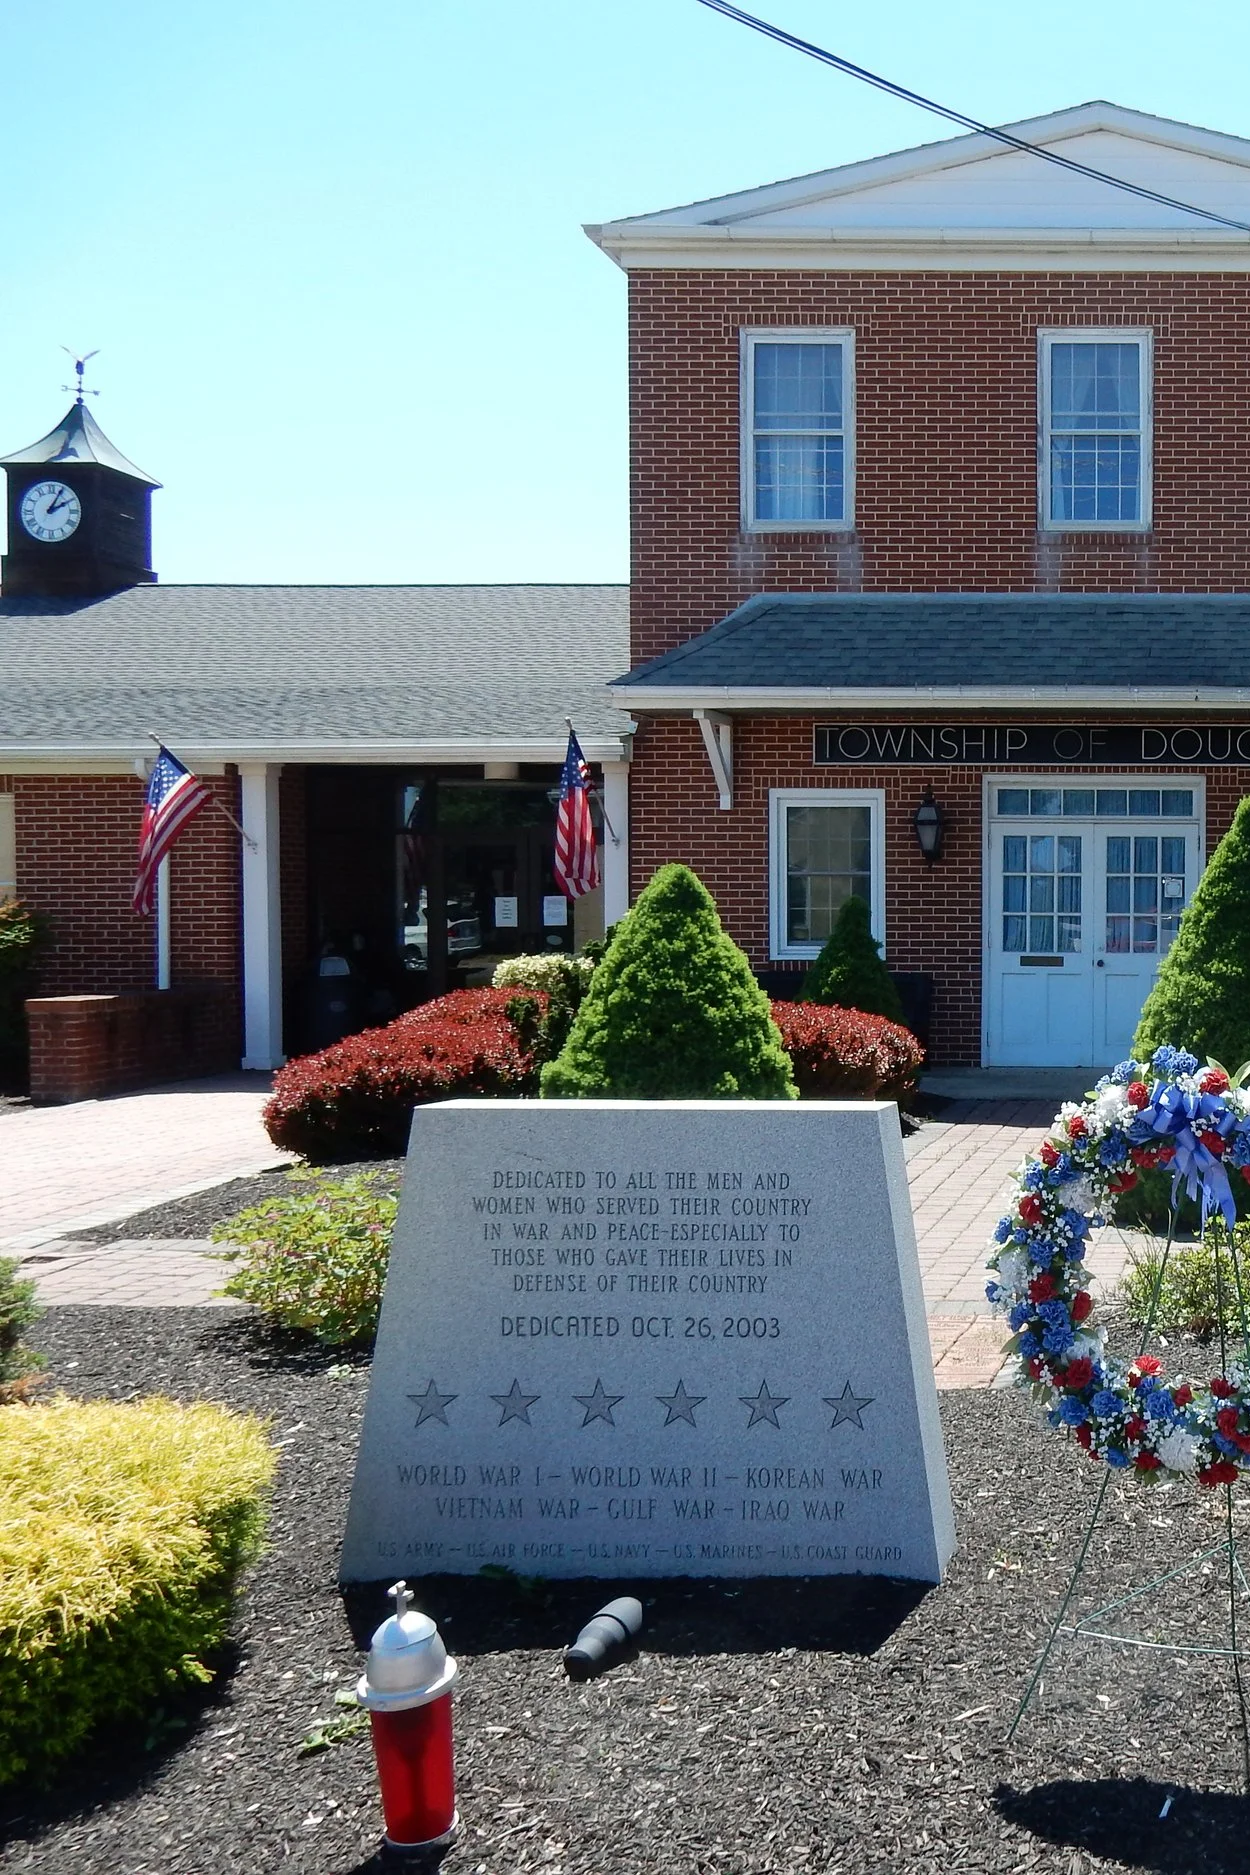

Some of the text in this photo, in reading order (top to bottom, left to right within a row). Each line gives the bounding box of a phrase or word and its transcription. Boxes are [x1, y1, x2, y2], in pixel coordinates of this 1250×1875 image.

[816, 727, 1028, 760] TOWNSHIP
[1053, 728, 1109, 761] OF
[493, 1171, 790, 1190] DEDICATED TO ALL THE MEN AND
[472, 1197, 812, 1216] WOMEN WHO SERVED THEIR COUNTRY
[483, 1223, 502, 1240] IN
[512, 1223, 550, 1240] WAR
[561, 1223, 597, 1240] AND
[779, 1224, 800, 1242] TO
[491, 1248, 792, 1267] THOSE WHO GAVE THEIR LIVES IN
[513, 1275, 768, 1293] DEFENSE OF THEIR COUNTRY
[501, 1316, 620, 1337] DEDICATED
[632, 1316, 675, 1338] OCT.
[723, 1317, 780, 1338] 2003
[397, 1465, 466, 1487] WORLD
[479, 1466, 521, 1487] WAR
[571, 1466, 641, 1488] WORLD
[650, 1467, 692, 1488] WAR
[746, 1468, 825, 1489] KOREAN
[841, 1469, 883, 1489] WAR
[436, 1498, 523, 1519] VIETNAM
[538, 1499, 580, 1519] WAR
[607, 1499, 656, 1520] GULF
[673, 1499, 715, 1520] WAR
[742, 1500, 789, 1521] IRAQ
[803, 1500, 845, 1521] WAR
[405, 1543, 443, 1558] ARMY
[492, 1543, 516, 1558] AIR
[523, 1543, 565, 1558] FORCE
[615, 1543, 652, 1558] NAVY
[700, 1544, 762, 1559] MARINES
[807, 1545, 849, 1560] COAST
[855, 1546, 903, 1560] GUARD
